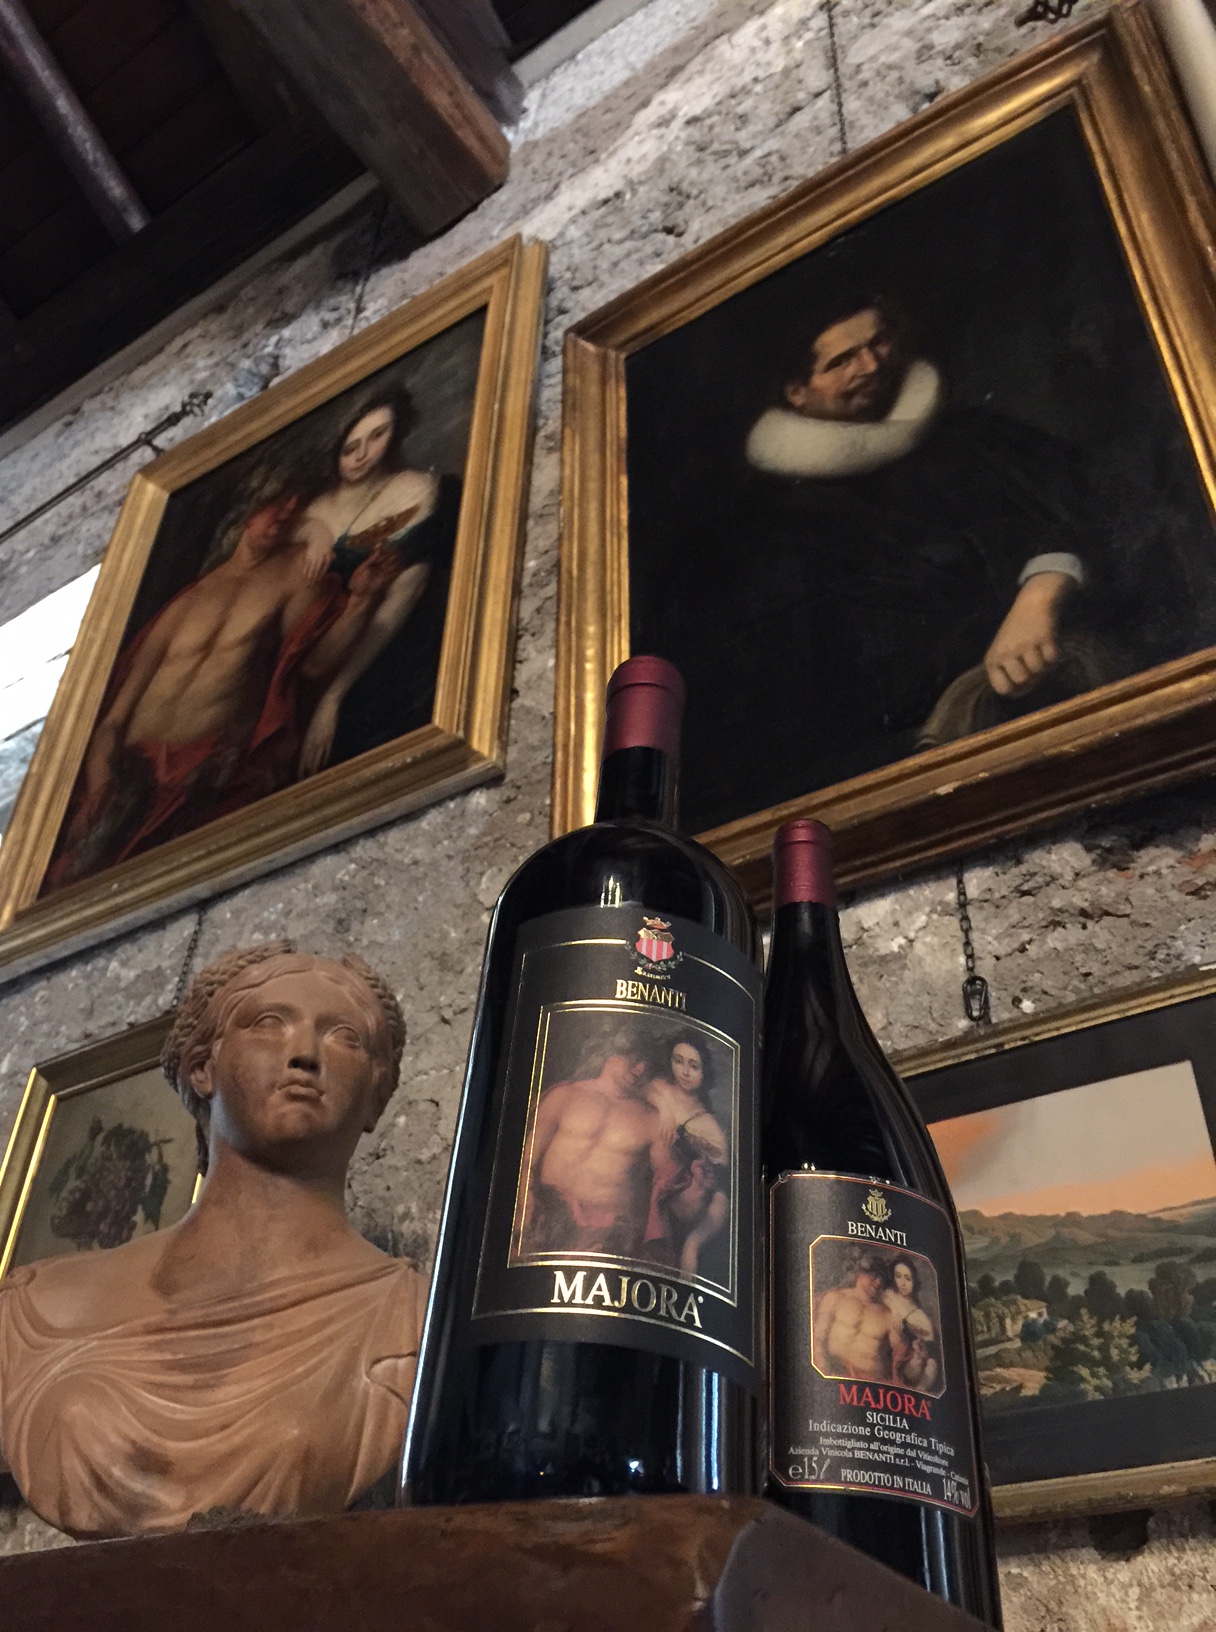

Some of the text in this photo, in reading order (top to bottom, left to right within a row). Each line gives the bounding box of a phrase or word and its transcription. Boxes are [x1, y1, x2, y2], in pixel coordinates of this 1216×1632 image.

[615, 979, 687, 1011] BENANTI
[847, 1221, 907, 1246] BENANTI
[551, 1270, 703, 1328] MAJORA
[838, 1383, 931, 1421] MAJORA
[866, 1411, 909, 1430] SICILIA
[808, 1419, 955, 1457] Indicazione Geografica Tipica
[819, 1436, 868, 1449] Imbottigliato
[869, 1441, 905, 1454] all'origine
[906, 1448, 917, 1458] dal
[788, 1446, 819, 1455] Azienda
[821, 1446, 853, 1458] Vinicola
[854, 1449, 895, 1464] BENANTI
[840, 1468, 892, 1487] PRODOTTO
[893, 1475, 904, 1489] IN
[905, 1477, 932, 1496] ITALIA
[960, 1487, 972, 1510] vol
